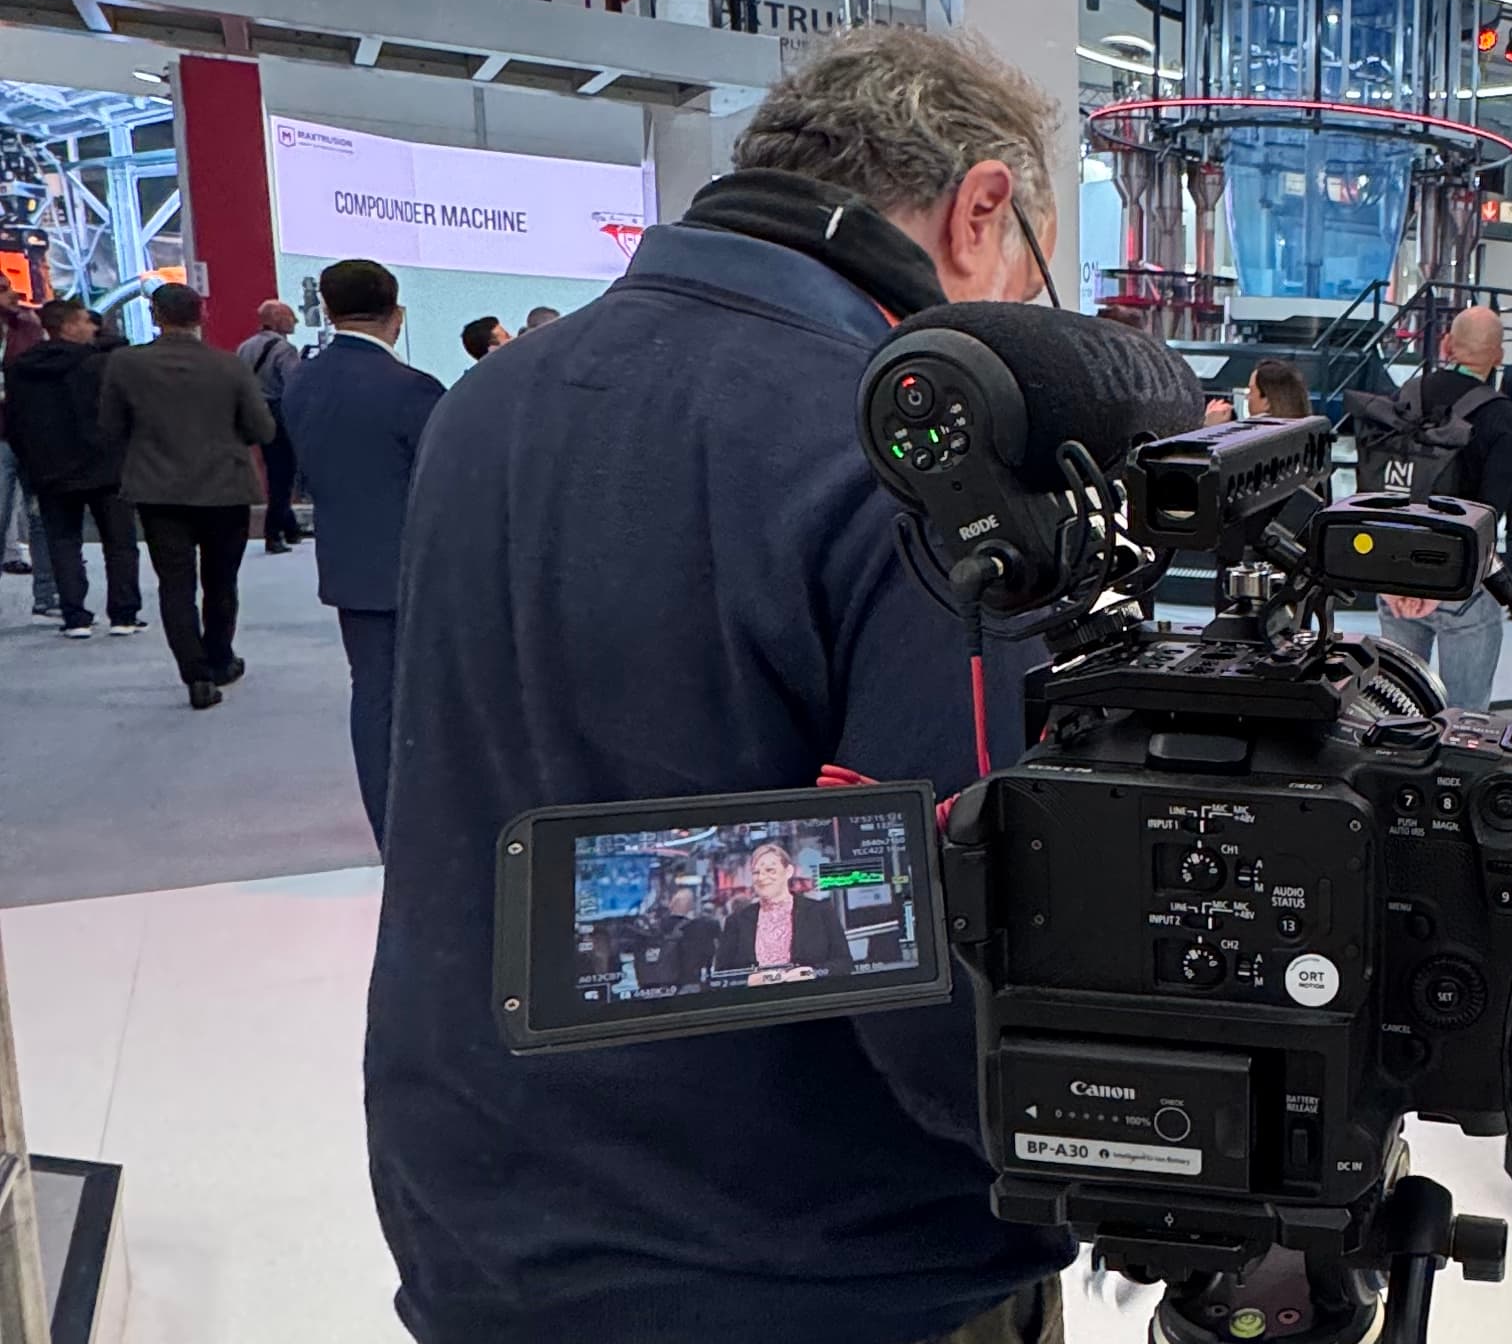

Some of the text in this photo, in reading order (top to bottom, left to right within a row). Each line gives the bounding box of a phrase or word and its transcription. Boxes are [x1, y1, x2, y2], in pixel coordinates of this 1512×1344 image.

[334, 190, 528, 233] COMPOUNDER MACHINE
[958, 513, 1001, 542] RØDE
[1403, 794, 1414, 807] 7
[1442, 797, 1452, 810] 8
[1168, 806, 1187, 816] LINE
[1220, 844, 1240, 855] CH1
[1272, 885, 1305, 898] AUDIO
[1501, 891, 1511, 903] 9
[1169, 901, 1188, 912] LINE
[1271, 896, 1306, 909] STATUS
[1281, 919, 1296, 932] 13
[1220, 939, 1240, 951] CH2
[1298, 970, 1326, 982] ORT
[1069, 1080, 1137, 1101] Canon
[1026, 1140, 1090, 1158] BP-A30
[1336, 1161, 1363, 1172] DC IN
